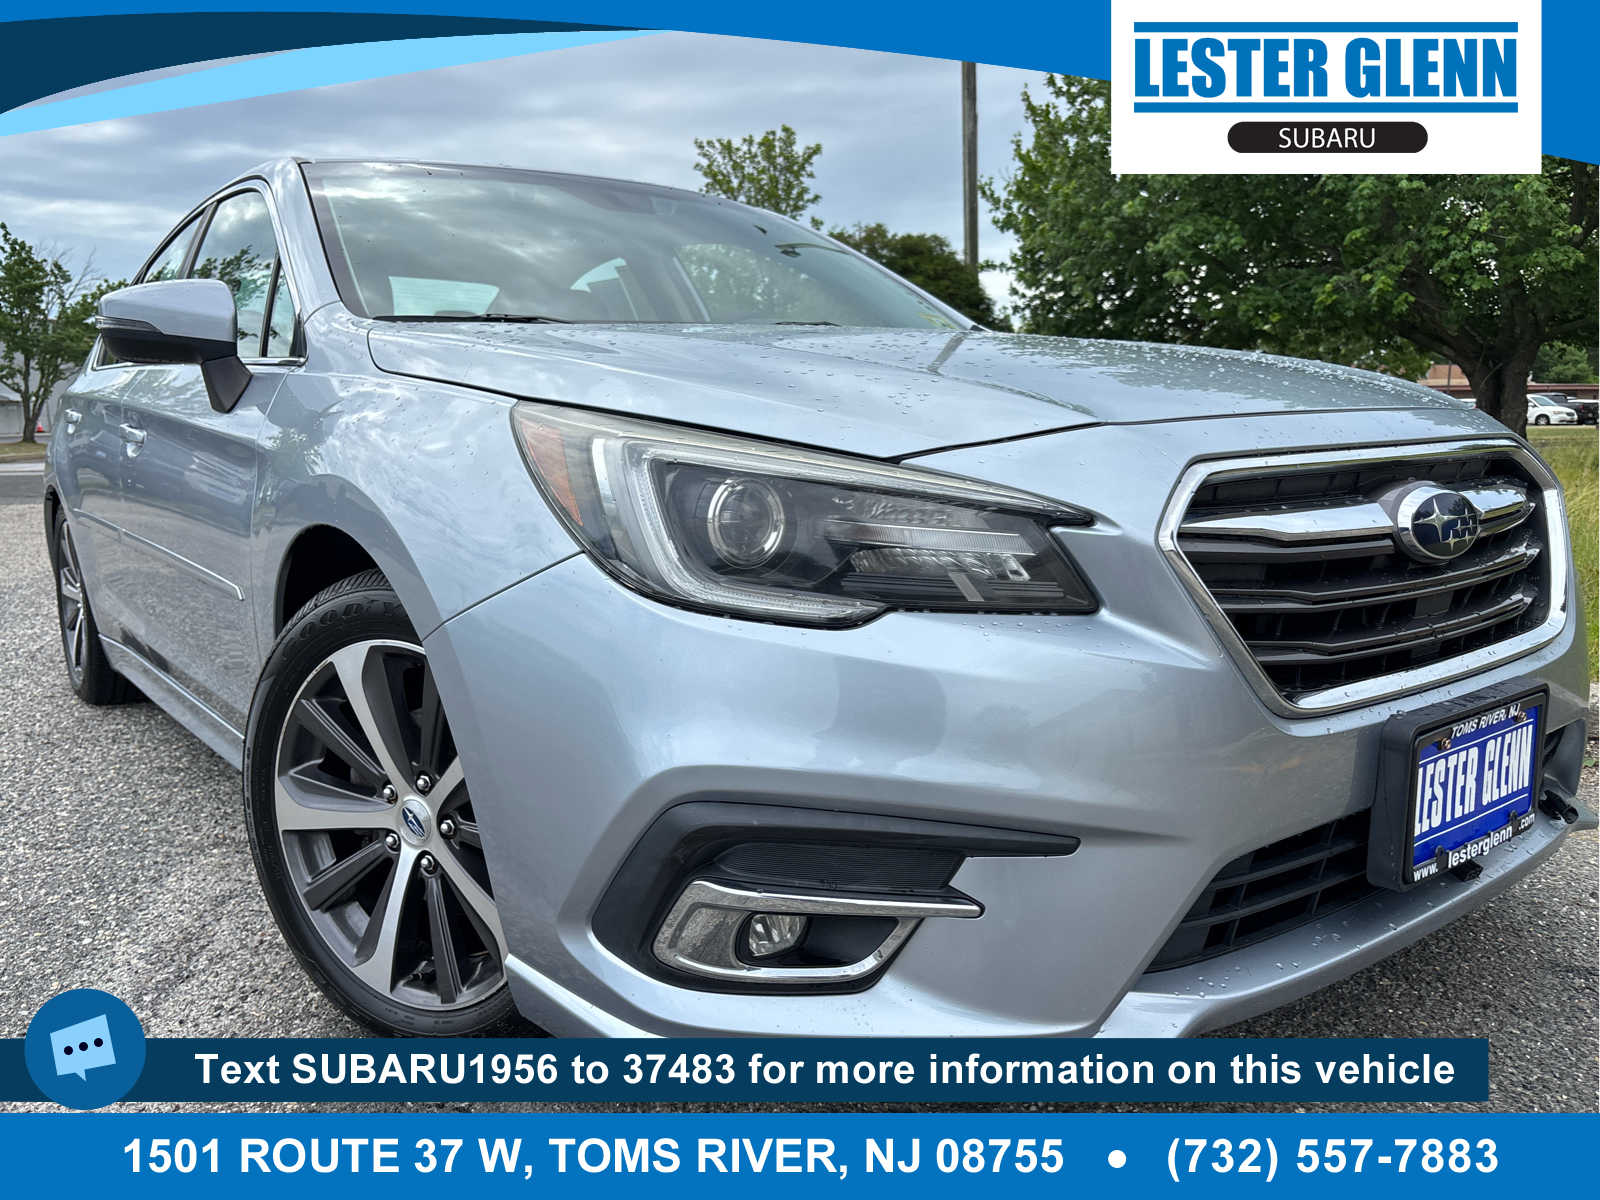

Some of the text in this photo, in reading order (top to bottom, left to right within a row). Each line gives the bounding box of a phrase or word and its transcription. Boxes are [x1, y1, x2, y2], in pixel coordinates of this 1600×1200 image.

[1451, 718, 1479, 740] TOMS
[1508, 702, 1521, 719] NJ
[1414, 724, 1534, 837] LESTER GLENN
[1413, 813, 1536, 882] www. lesterglenn .com
